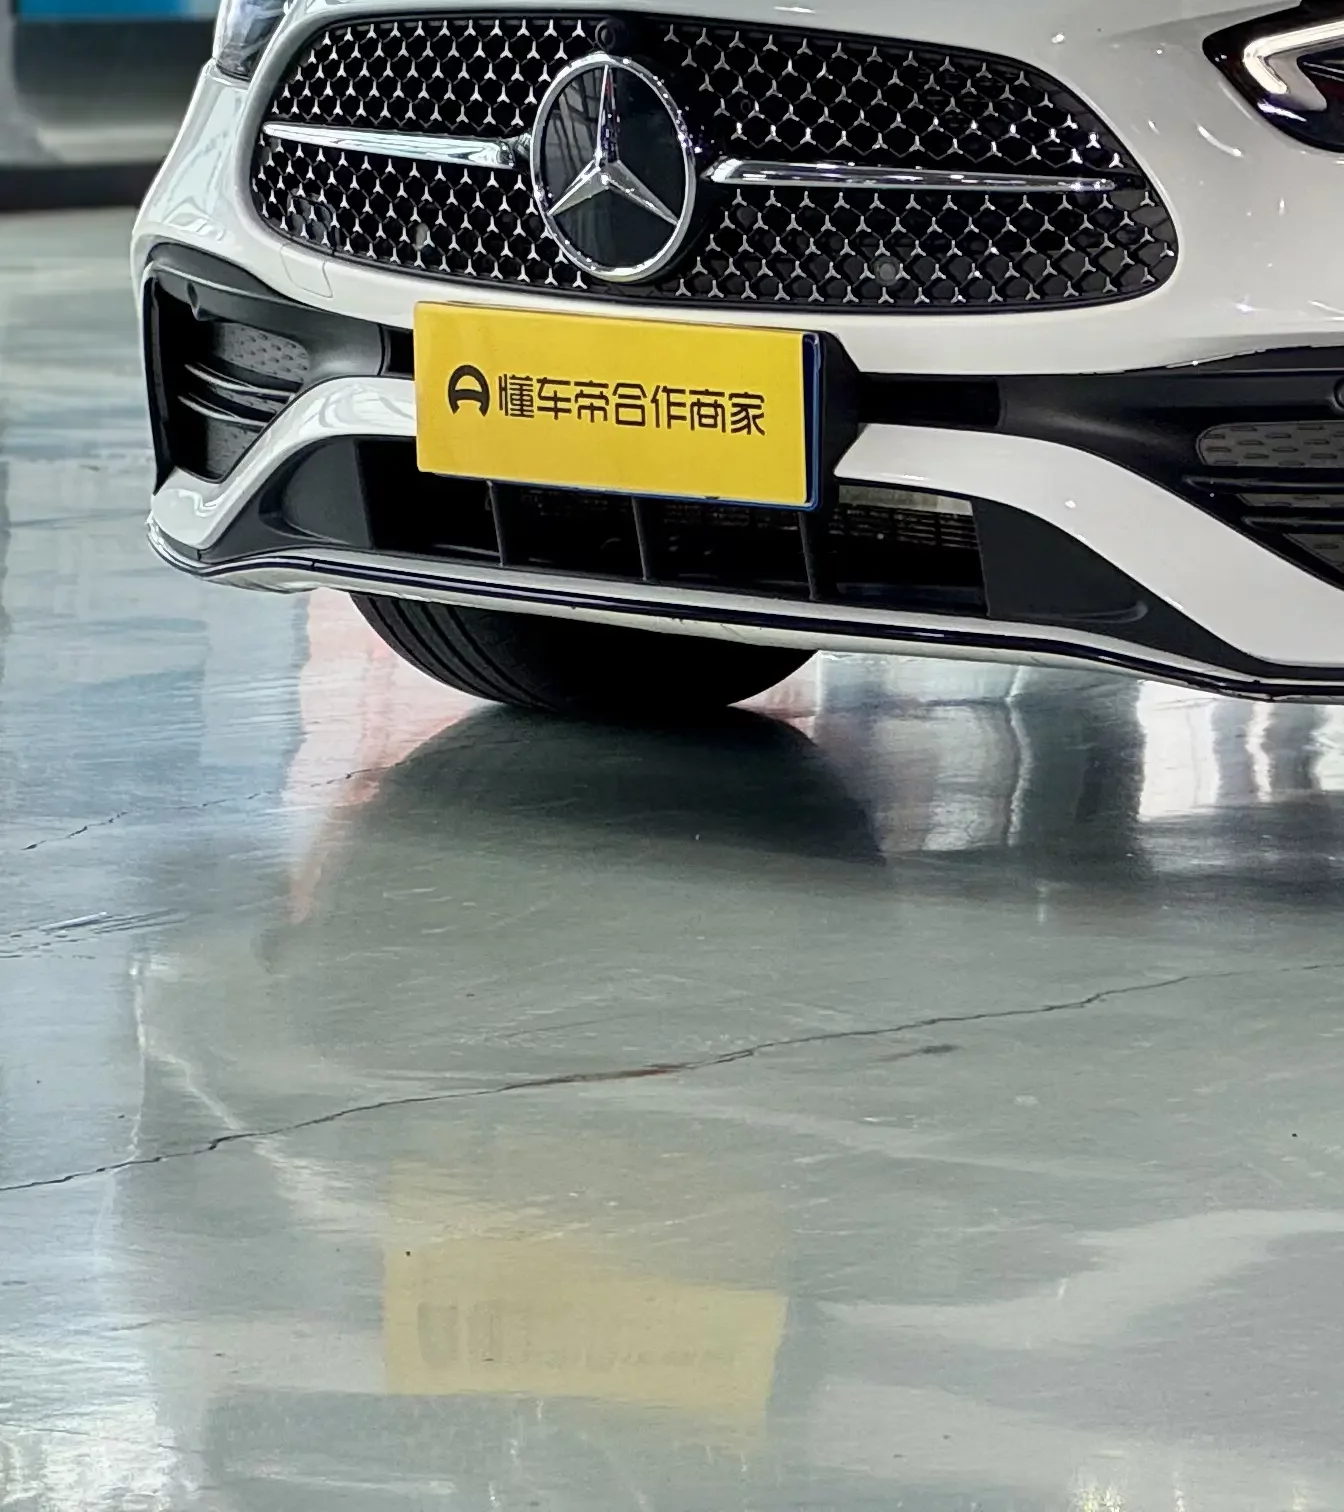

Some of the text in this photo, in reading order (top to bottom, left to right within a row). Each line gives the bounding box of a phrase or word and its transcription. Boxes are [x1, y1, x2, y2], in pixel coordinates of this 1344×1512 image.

[498, 374, 765, 436] 懂车帝合作商家
